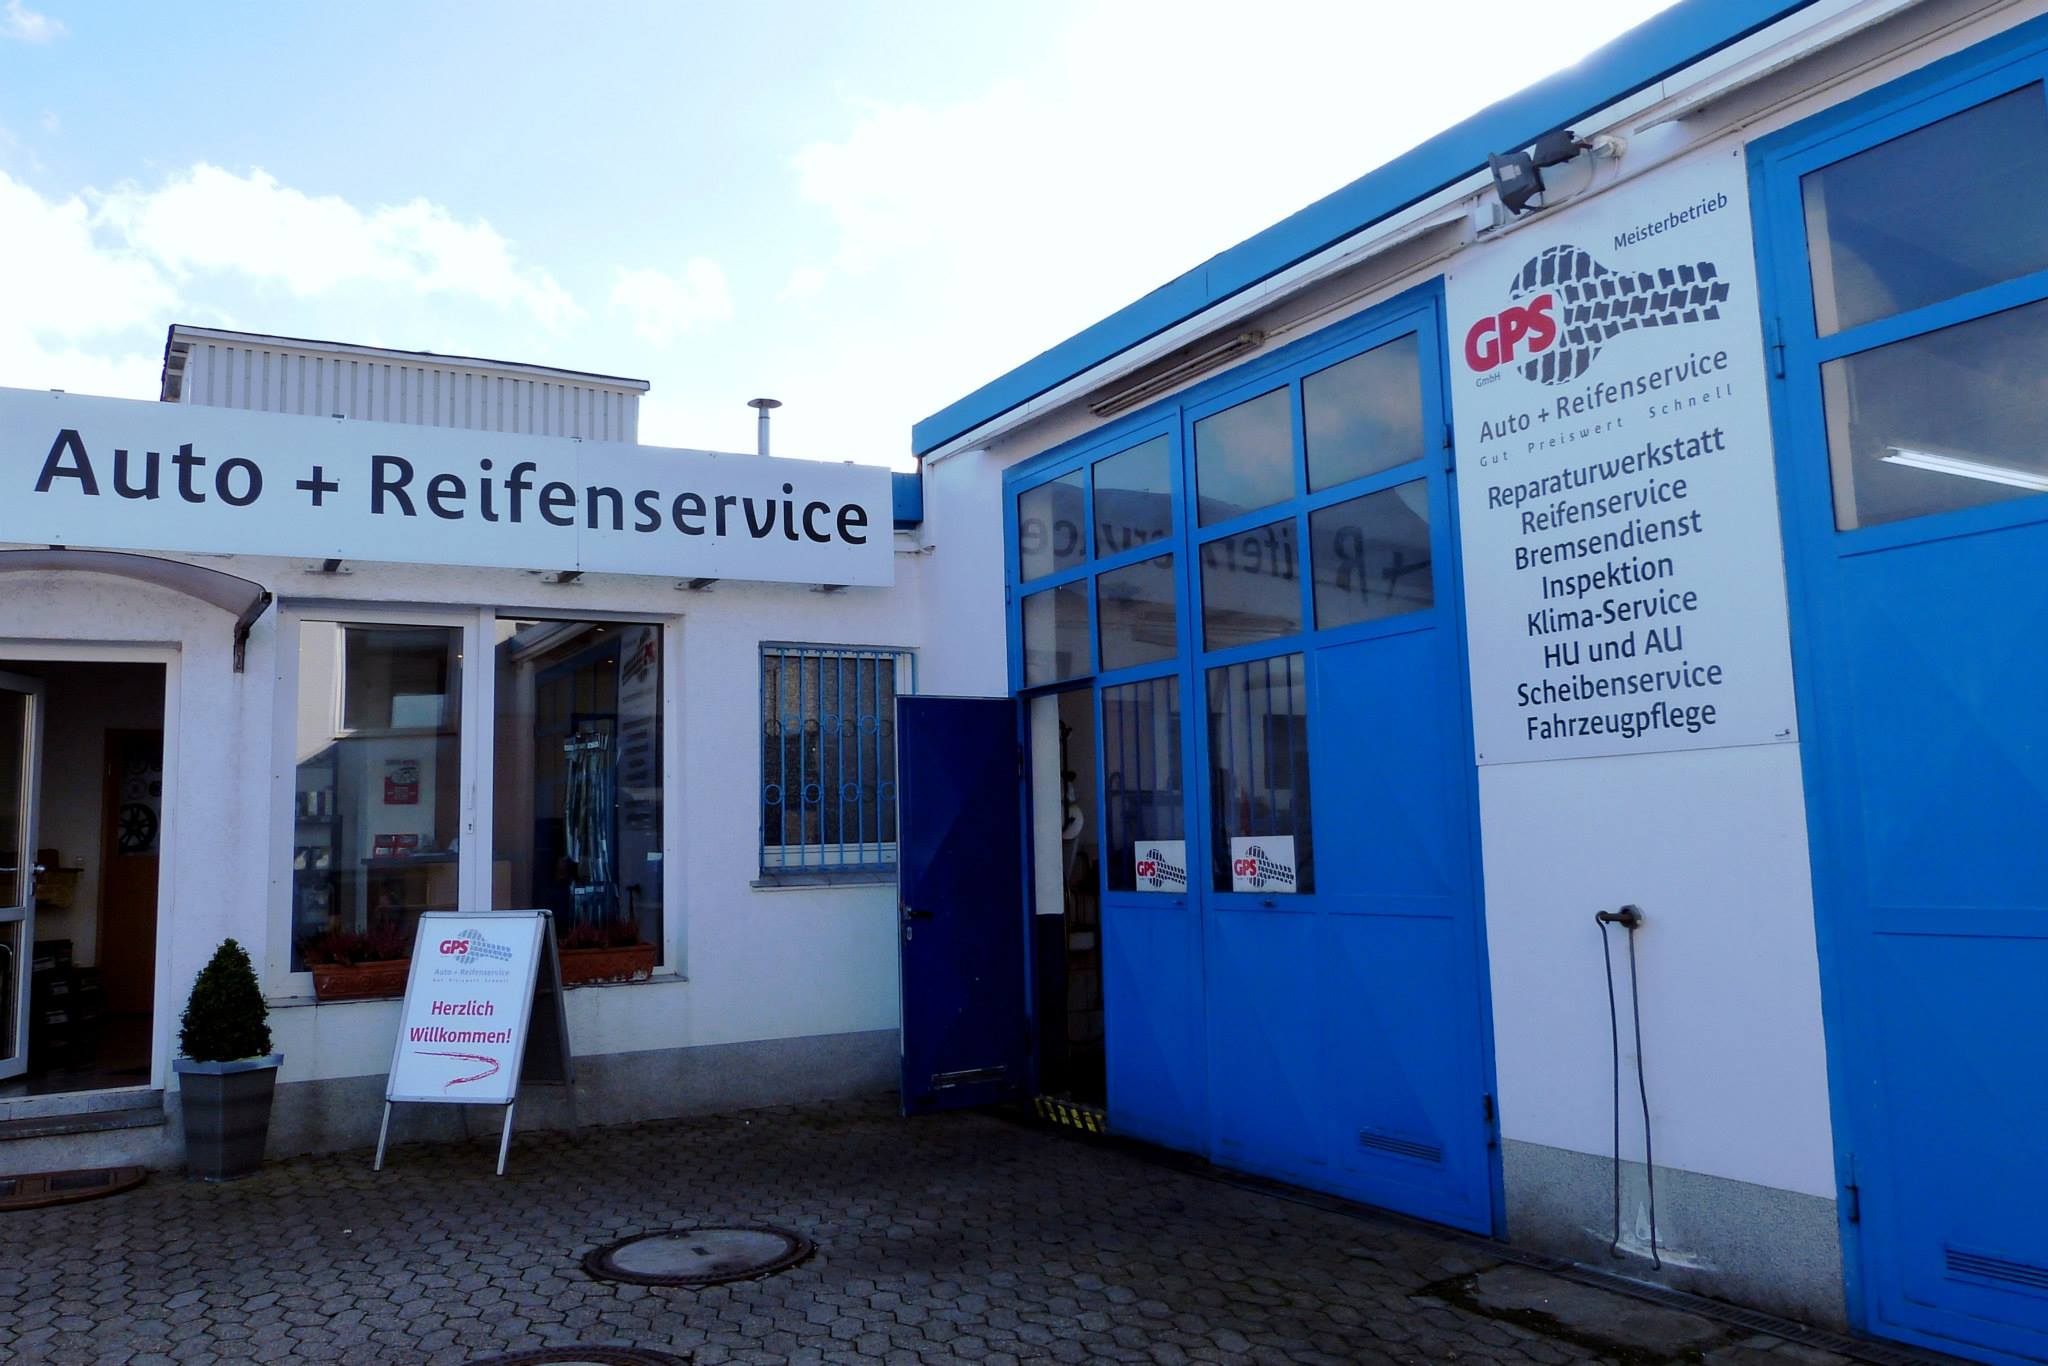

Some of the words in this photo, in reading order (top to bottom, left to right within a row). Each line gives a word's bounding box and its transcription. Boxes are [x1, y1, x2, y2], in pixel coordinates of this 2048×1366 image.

[1613, 192, 1728, 251] Meisterbetrieb
[1465, 294, 1557, 373] GPS
[1476, 373, 1502, 388] GmbH
[1480, 409, 1530, 443] Auto
[1537, 408, 1550, 423] +
[1557, 349, 1728, 419] Reifenservice
[1480, 450, 1509, 467] Gut
[1528, 417, 1624, 453] Preiswert
[1648, 383, 1733, 418] Schnell
[34, 429, 264, 506] Auto
[296, 465, 339, 507] +
[371, 455, 869, 546] Reifenservice
[1488, 427, 1726, 510] Reparaturwerkstatt
[1521, 478, 1688, 535] Reifenservice
[1515, 510, 1703, 570] Bremsendienst
[1542, 557, 1674, 600] Inspektion
[1528, 589, 1698, 636] Klima-Service
[1544, 641, 1580, 669] HU
[1588, 631, 1636, 661] und
[1645, 626, 1683, 656] AU
[1517, 661, 1723, 707] Scheibenservice
[1527, 702, 1717, 741] Fahrzeugpflege
[1137, 861, 1156, 877] GPS
[1234, 859, 1257, 877] GPS
[439, 940, 470, 955] GPS
[431, 1000, 494, 1016] Herzlich
[409, 1027, 512, 1044] Willkommen!
